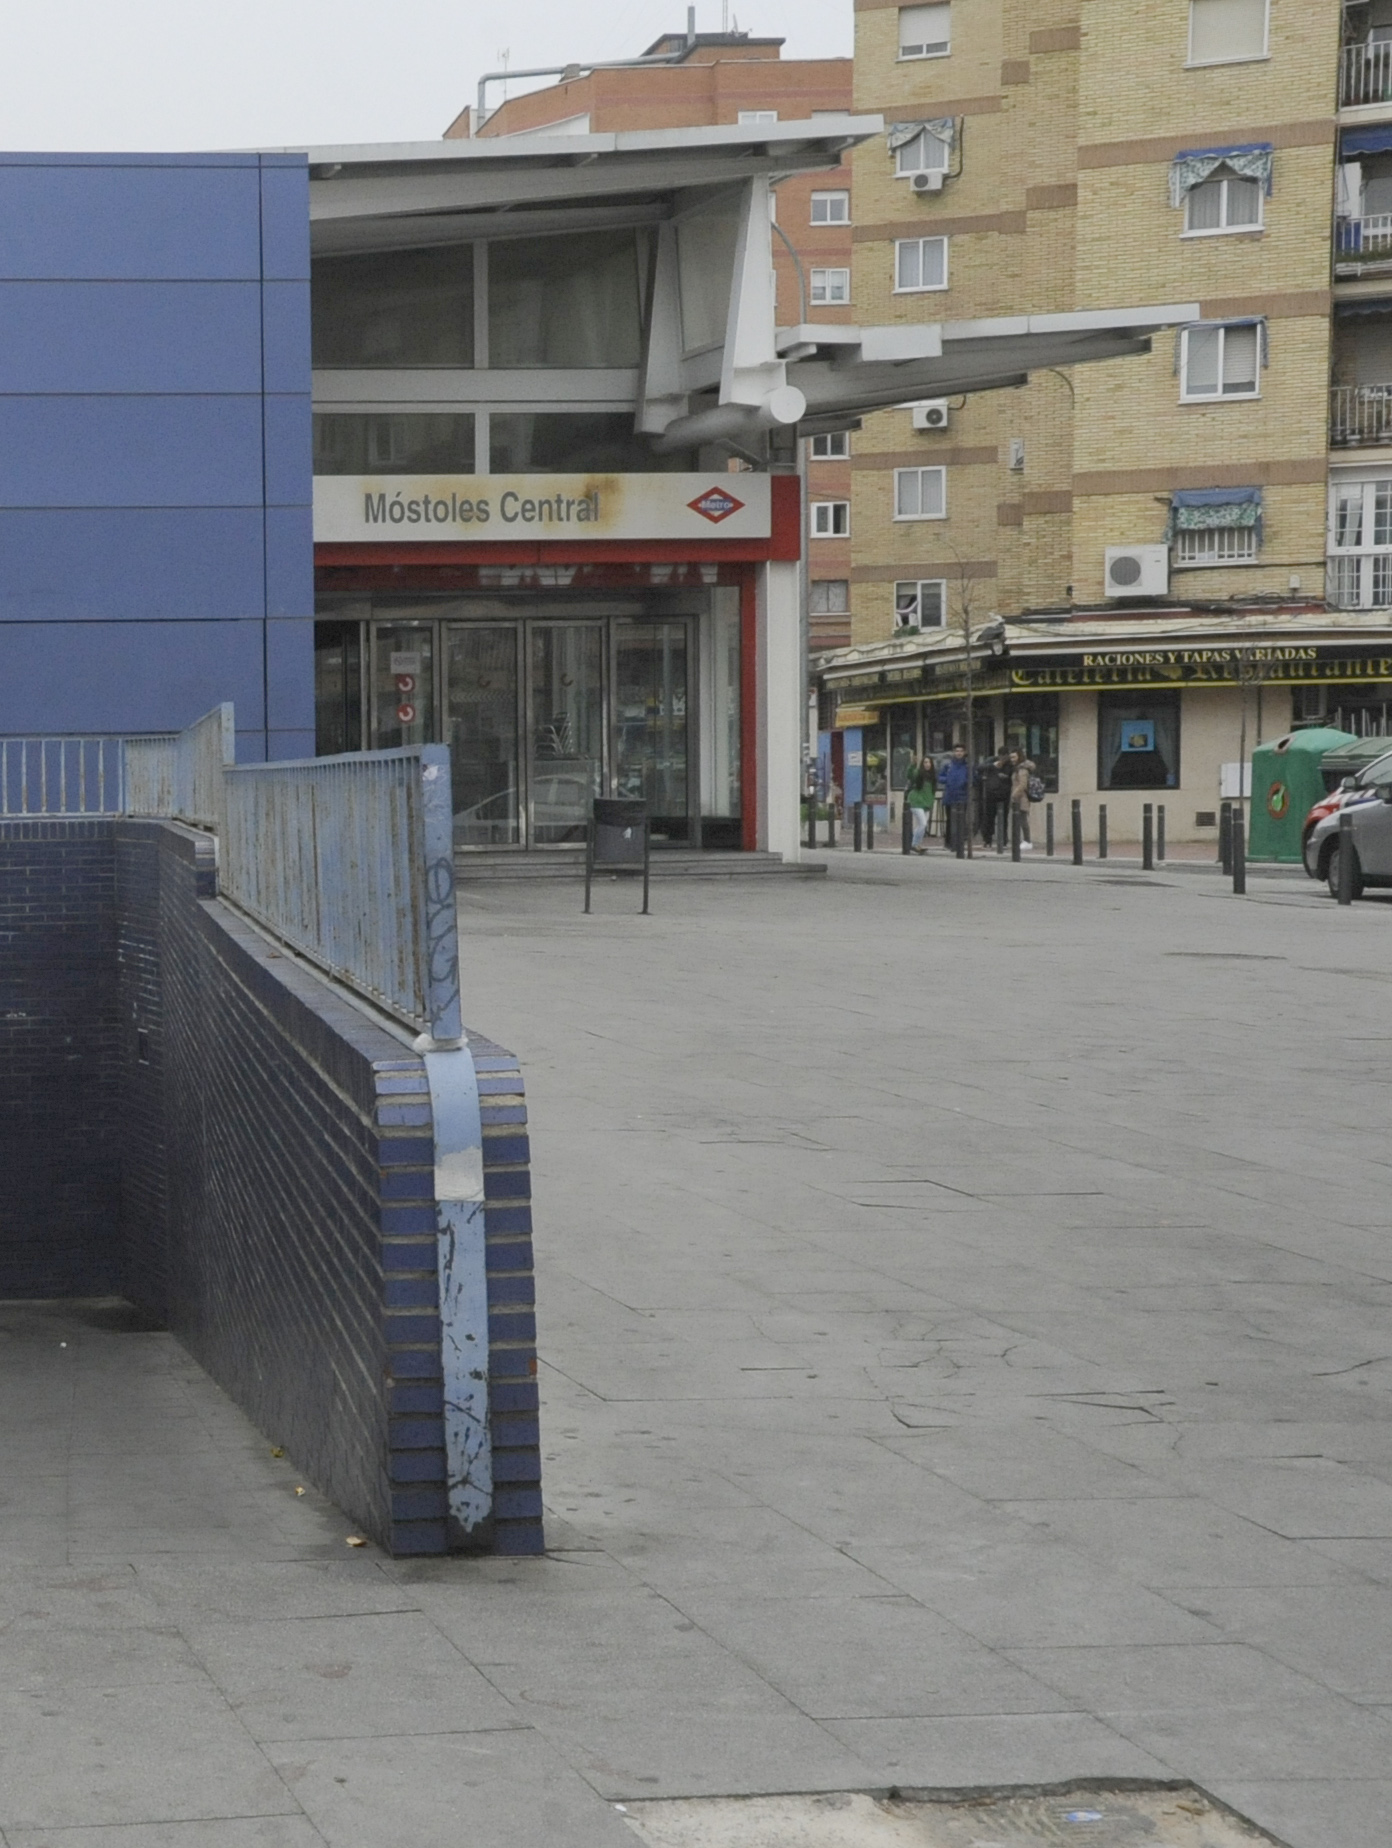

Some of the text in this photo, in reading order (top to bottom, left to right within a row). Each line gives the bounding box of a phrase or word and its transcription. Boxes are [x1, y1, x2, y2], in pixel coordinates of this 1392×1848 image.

[365, 491, 599, 524] Móstoles Central
[701, 500, 730, 509] Metro
[1083, 648, 1317, 666] RACIONES Y TAPAS VARIADAS
